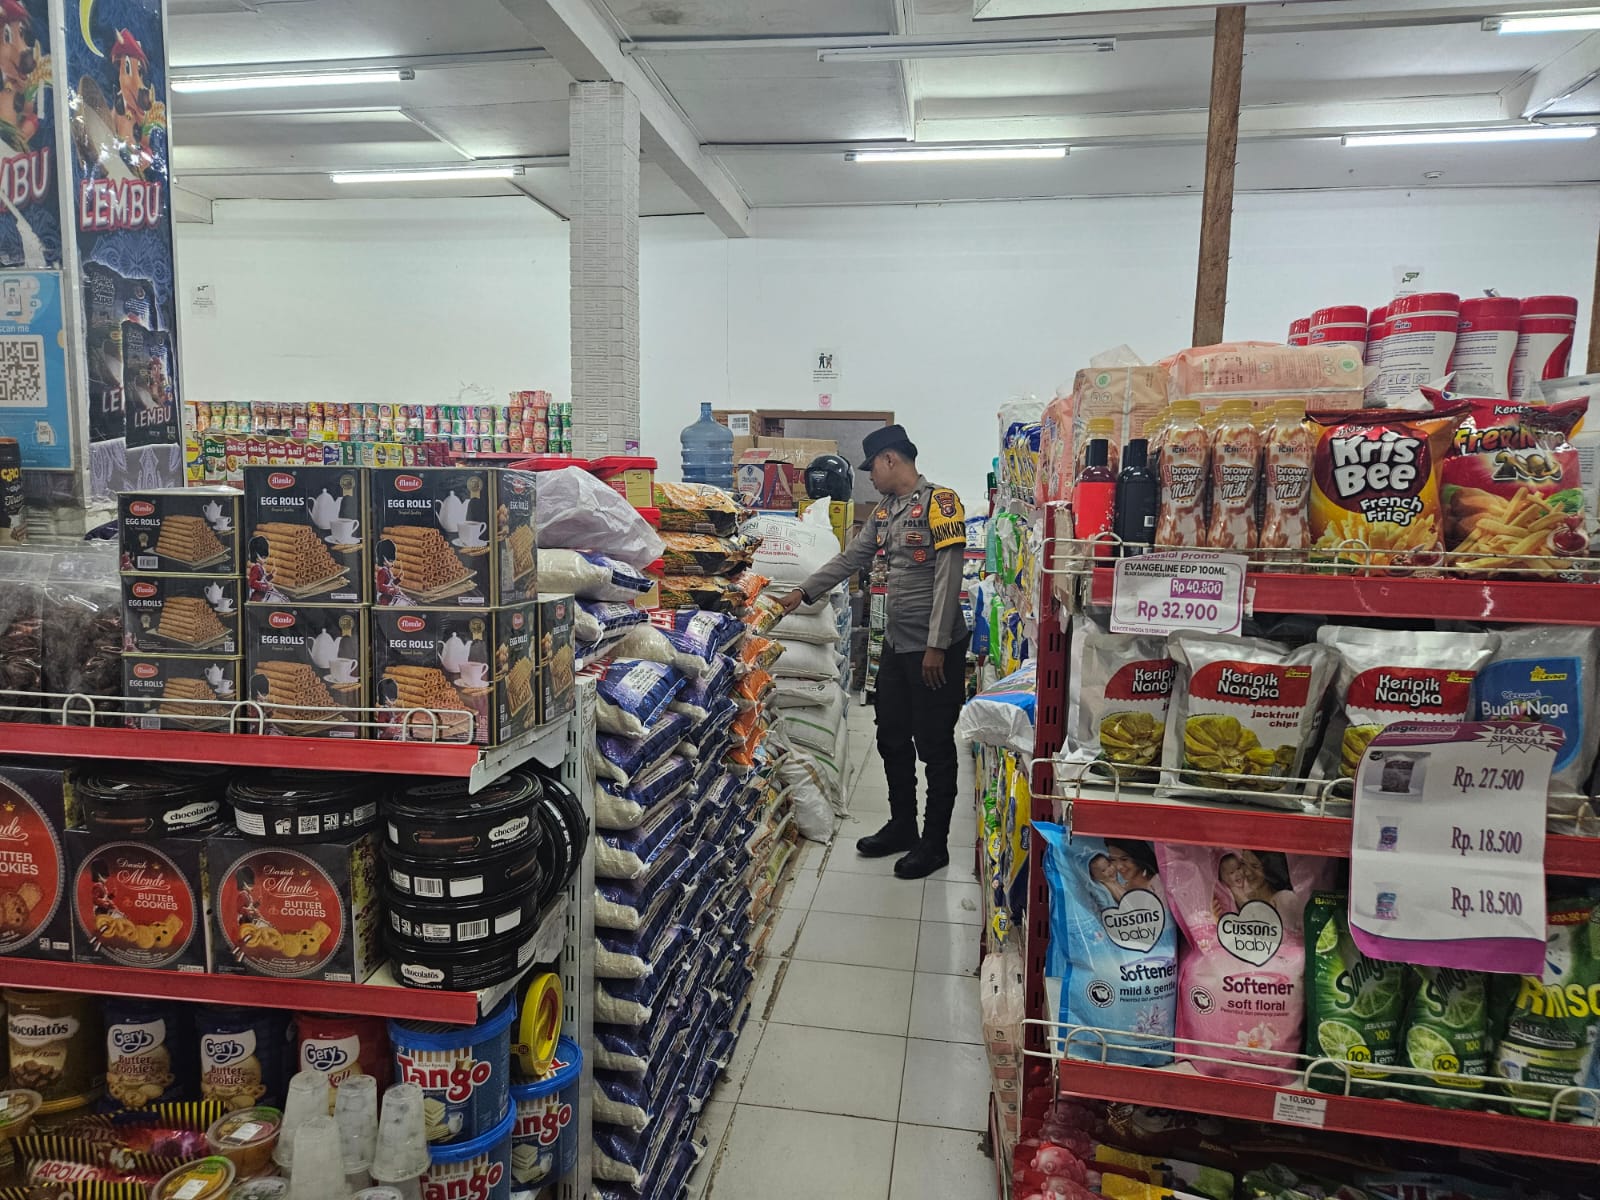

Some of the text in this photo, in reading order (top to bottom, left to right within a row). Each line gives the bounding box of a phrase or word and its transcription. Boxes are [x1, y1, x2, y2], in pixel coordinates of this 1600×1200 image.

[81, 180, 161, 230] LEMBU
[102, 386, 124, 413] LE
[134, 407, 171, 428] LEMBU
[1332, 432, 1420, 466] Kris
[1171, 467, 1201, 475] brown
[1172, 474, 1198, 483] sugar
[1223, 467, 1253, 475] brown
[1223, 475, 1249, 483] sugar
[1277, 475, 1304, 483] sugar
[1334, 463, 1416, 496] Bee
[1171, 484, 1196, 499] Milk
[1221, 484, 1246, 500] Milk
[1276, 484, 1301, 500] Milk
[261, 496, 305, 506] EGG ROLLS
[387, 499, 432, 509] EGG ROLLS
[1360, 497, 1422, 512] French
[125, 517, 161, 527] EGG ROLLS
[1366, 508, 1415, 525] Fries
[1180, 551, 1220, 560] Promo
[1124, 562, 1227, 576] EVANGELINE EDP 100ML
[1172, 580, 1185, 594] Rp
[128, 599, 162, 608] EGG ROLLS
[1137, 600, 1218, 622] Rp 32.900
[261, 635, 305, 645] EGG ROLLS
[389, 639, 434, 649] EGG ROLLS
[129, 679, 163, 688] EGG ROLLS
[1222, 668, 1279, 686] Keripik
[1379, 674, 1440, 692] Keripik
[1217, 680, 1280, 700] Nangka
[1375, 687, 1443, 706] Nangka
[1251, 709, 1300, 721] jackfruit
[1481, 701, 1569, 718] Buah Naga
[1268, 719, 1299, 729] chips
[1494, 727, 1545, 737] HARGA
[1490, 735, 1547, 745] SPESIAL
[1453, 766, 1525, 792] Rp. 27.500
[1451, 827, 1523, 856] Rp. 18.500
[0, 850, 33, 863] TTER
[117, 869, 172, 890] Monde
[262, 877, 319, 898] Monde
[134, 899, 178, 911] COOKIES
[137, 892, 175, 903] BUTTER
[1450, 887, 1523, 917] Rp. 18.500
[280, 907, 326, 918] COOKIES
[284, 900, 322, 911] BUTTER
[1104, 909, 1160, 929] Cussons
[1118, 927, 1157, 942] baby
[1222, 919, 1278, 937] Cussons
[1234, 937, 1273, 955] baby
[1119, 964, 1177, 982] Softener
[1119, 981, 1176, 997] mild & gentle
[1222, 976, 1295, 996] Softener
[1227, 999, 1286, 1011] soft floral
[114, 1029, 152, 1053] Gery
[205, 1039, 244, 1063] Gery
[305, 1043, 347, 1070] Gery
[118, 1055, 150, 1065] Butter
[117, 1065, 154, 1075] Cookies
[211, 1065, 242, 1075] Butter
[207, 1075, 247, 1085] Cookies
[397, 1053, 492, 1104] Tango
[513, 1104, 572, 1146] ango
